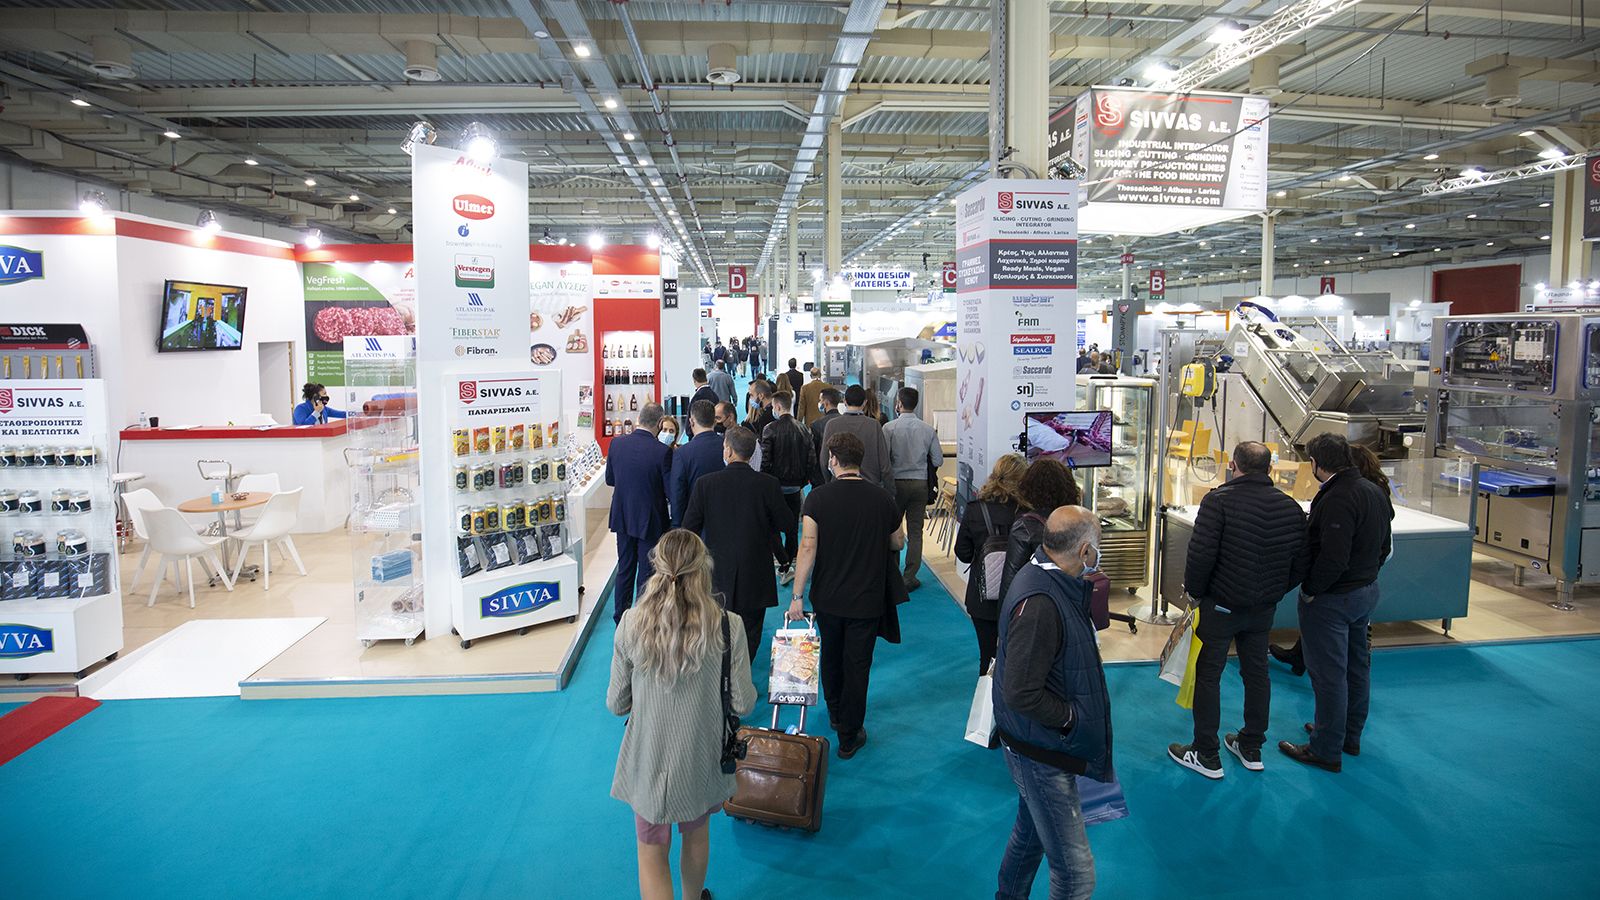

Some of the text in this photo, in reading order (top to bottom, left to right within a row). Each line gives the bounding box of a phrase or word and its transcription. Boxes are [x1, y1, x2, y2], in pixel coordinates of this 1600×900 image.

[1130, 110, 1231, 134] SIVVAS A.E.
[1118, 140, 1172, 150] INDUSTRIAL
[1138, 151, 1177, 159] CUTTING
[1094, 160, 1139, 168] TURNKEY
[1200, 163, 1226, 172] LINES
[1154, 171, 1178, 180] FOOD
[1180, 173, 1224, 182] INDUSTRY
[1118, 192, 1220, 205] www.sivvas.com
[454, 199, 494, 215] Ulmer
[1016, 200, 1053, 209] SIVVAS
[458, 265, 491, 273] Verstegen
[306, 276, 346, 286] VegFresh
[731, 274, 744, 289] D
[1152, 276, 1162, 291] B
[10, 327, 46, 336] DICK
[1023, 366, 1052, 374] Saccardo
[480, 387, 522, 398] SIVVAS
[17, 398, 64, 408] SIVVAS
[468, 406, 530, 416] ΠΑΝΑΡΙΣΜΑΤΑ
[490, 588, 552, 612] SIVVA
